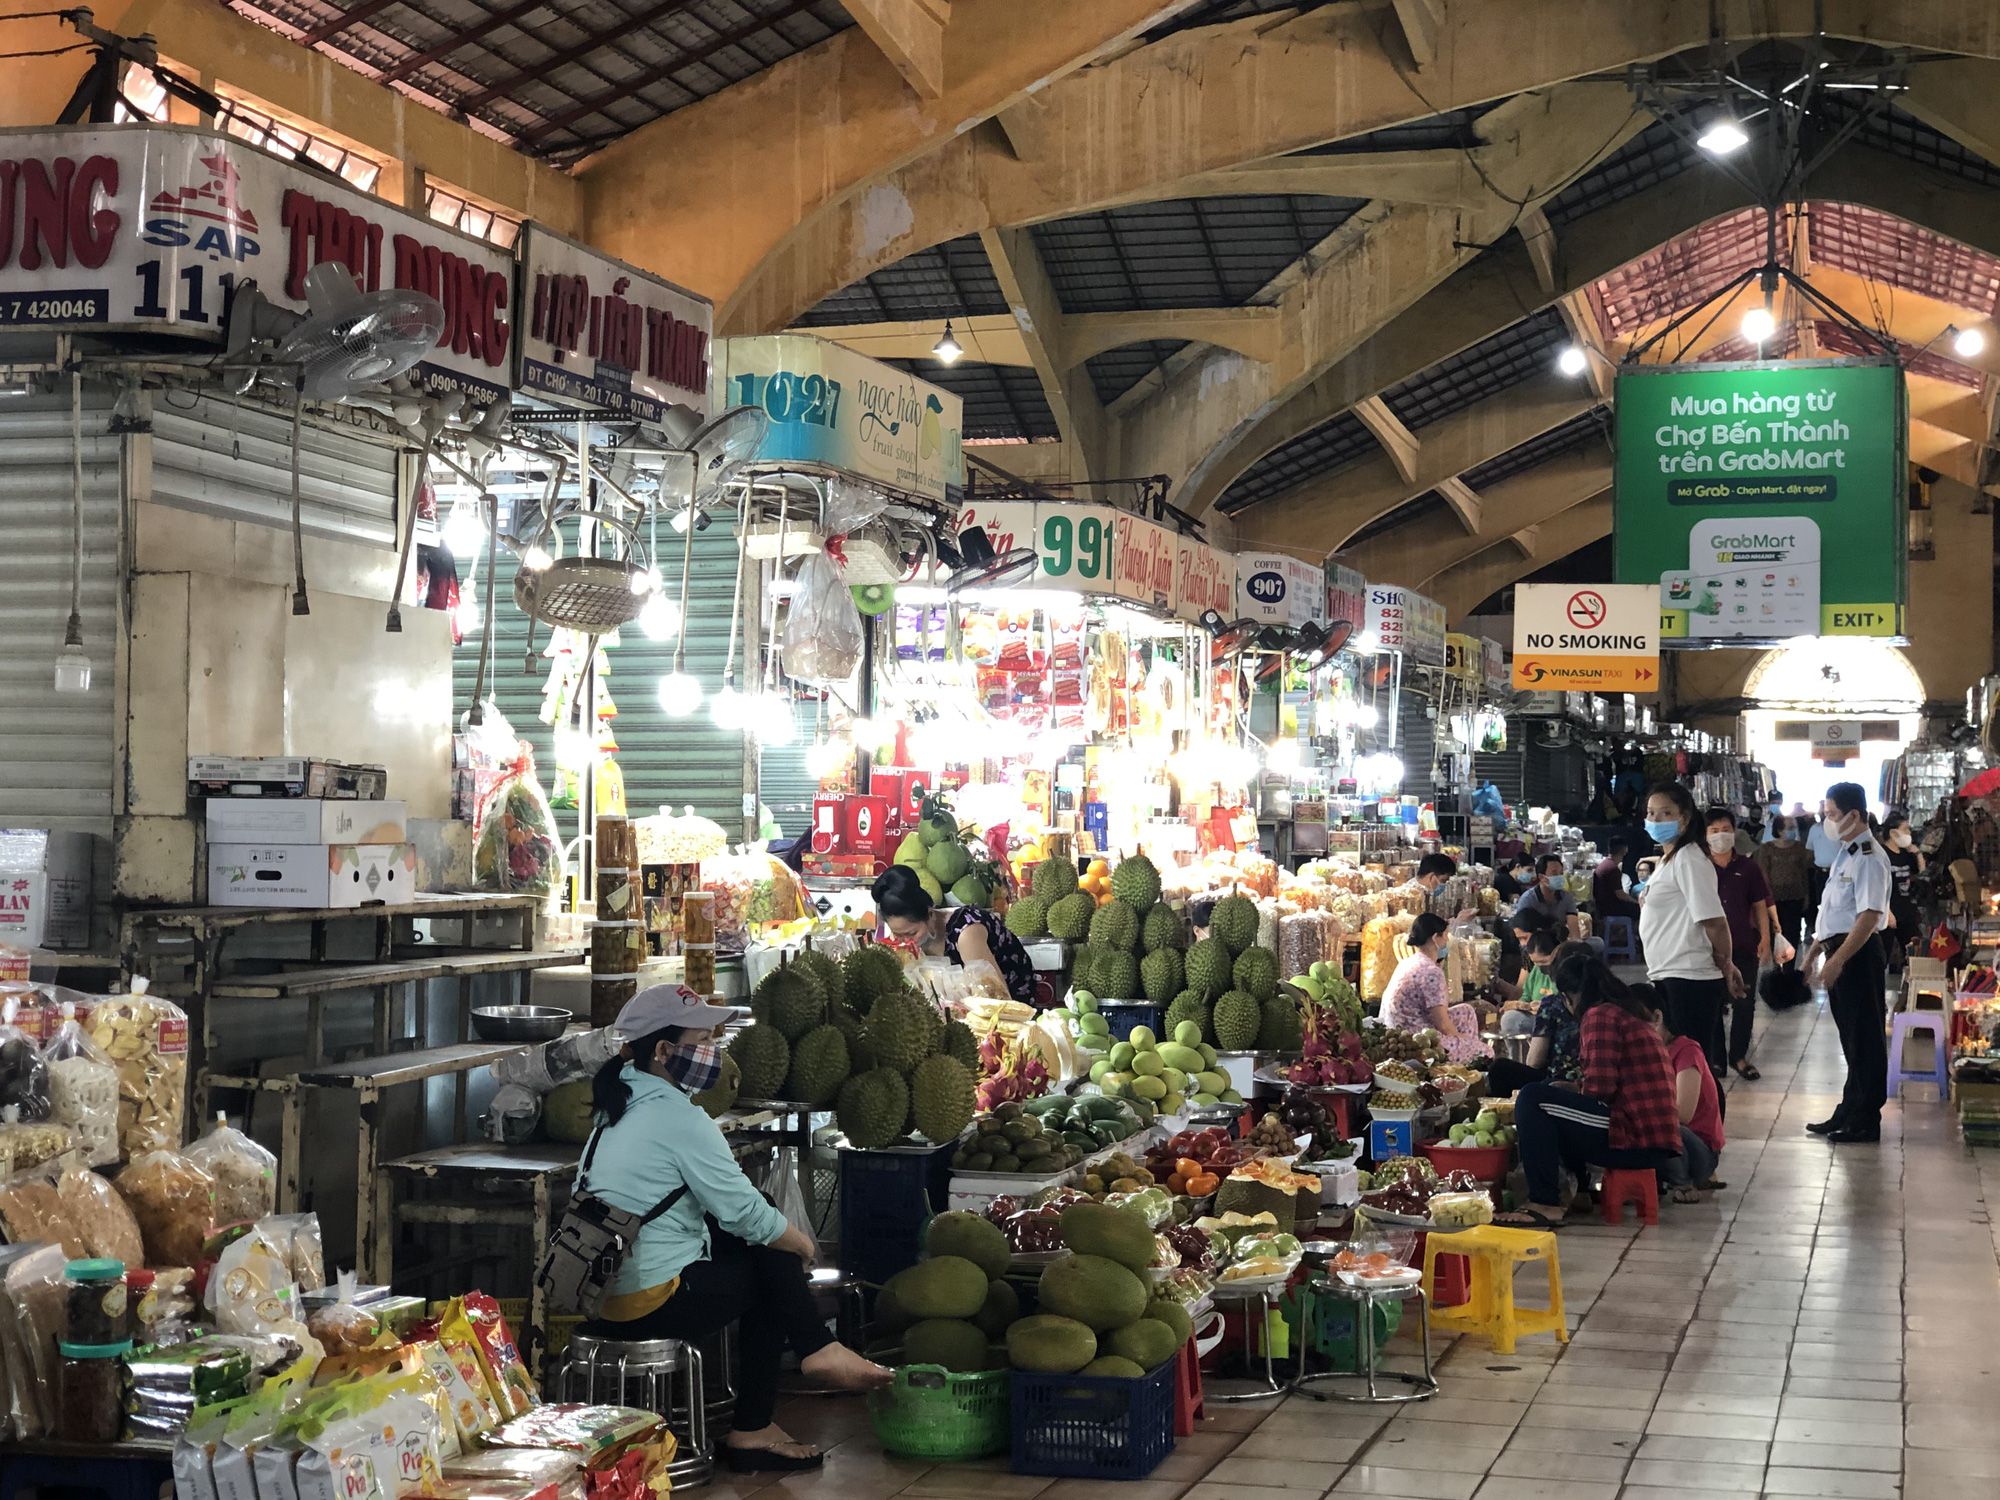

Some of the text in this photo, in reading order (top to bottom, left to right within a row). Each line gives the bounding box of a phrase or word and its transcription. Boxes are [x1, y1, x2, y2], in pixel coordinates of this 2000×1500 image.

[143, 218, 261, 263] SẠP
[11, 300, 96, 319] 7 420046
[583, 384, 601, 401] 201
[605, 392, 623, 409] 740
[735, 371, 842, 430] 1027
[1671, 389, 1837, 418] Mua hàng từ
[1655, 419, 1850, 450] Chợ Bến Thành
[873, 434, 917, 470] fruit shop
[1659, 448, 1845, 473] trên GrabMart
[1677, 487, 1692, 497] Mở
[1694, 484, 1730, 497] Grab
[1736, 486, 1760, 497] Chọn
[1761, 485, 1785, 495] Mart,
[1803, 484, 1827, 496] ngay!
[1042, 515, 1113, 580] 991
[1711, 534, 1795, 549] GrabMart
[1254, 560, 1283, 570] COFFEE
[1253, 578, 1283, 597] 907
[1262, 606, 1277, 615] TEA
[1833, 613, 1874, 628] EXIT
[1527, 634, 1646, 650] NO SMOKING
[1550, 668, 1623, 678] VINASUN TAXI
[872, 767, 902, 776] CHERRY
[814, 793, 845, 802] CHERRY
[278, 886, 308, 894] PREMIUM
